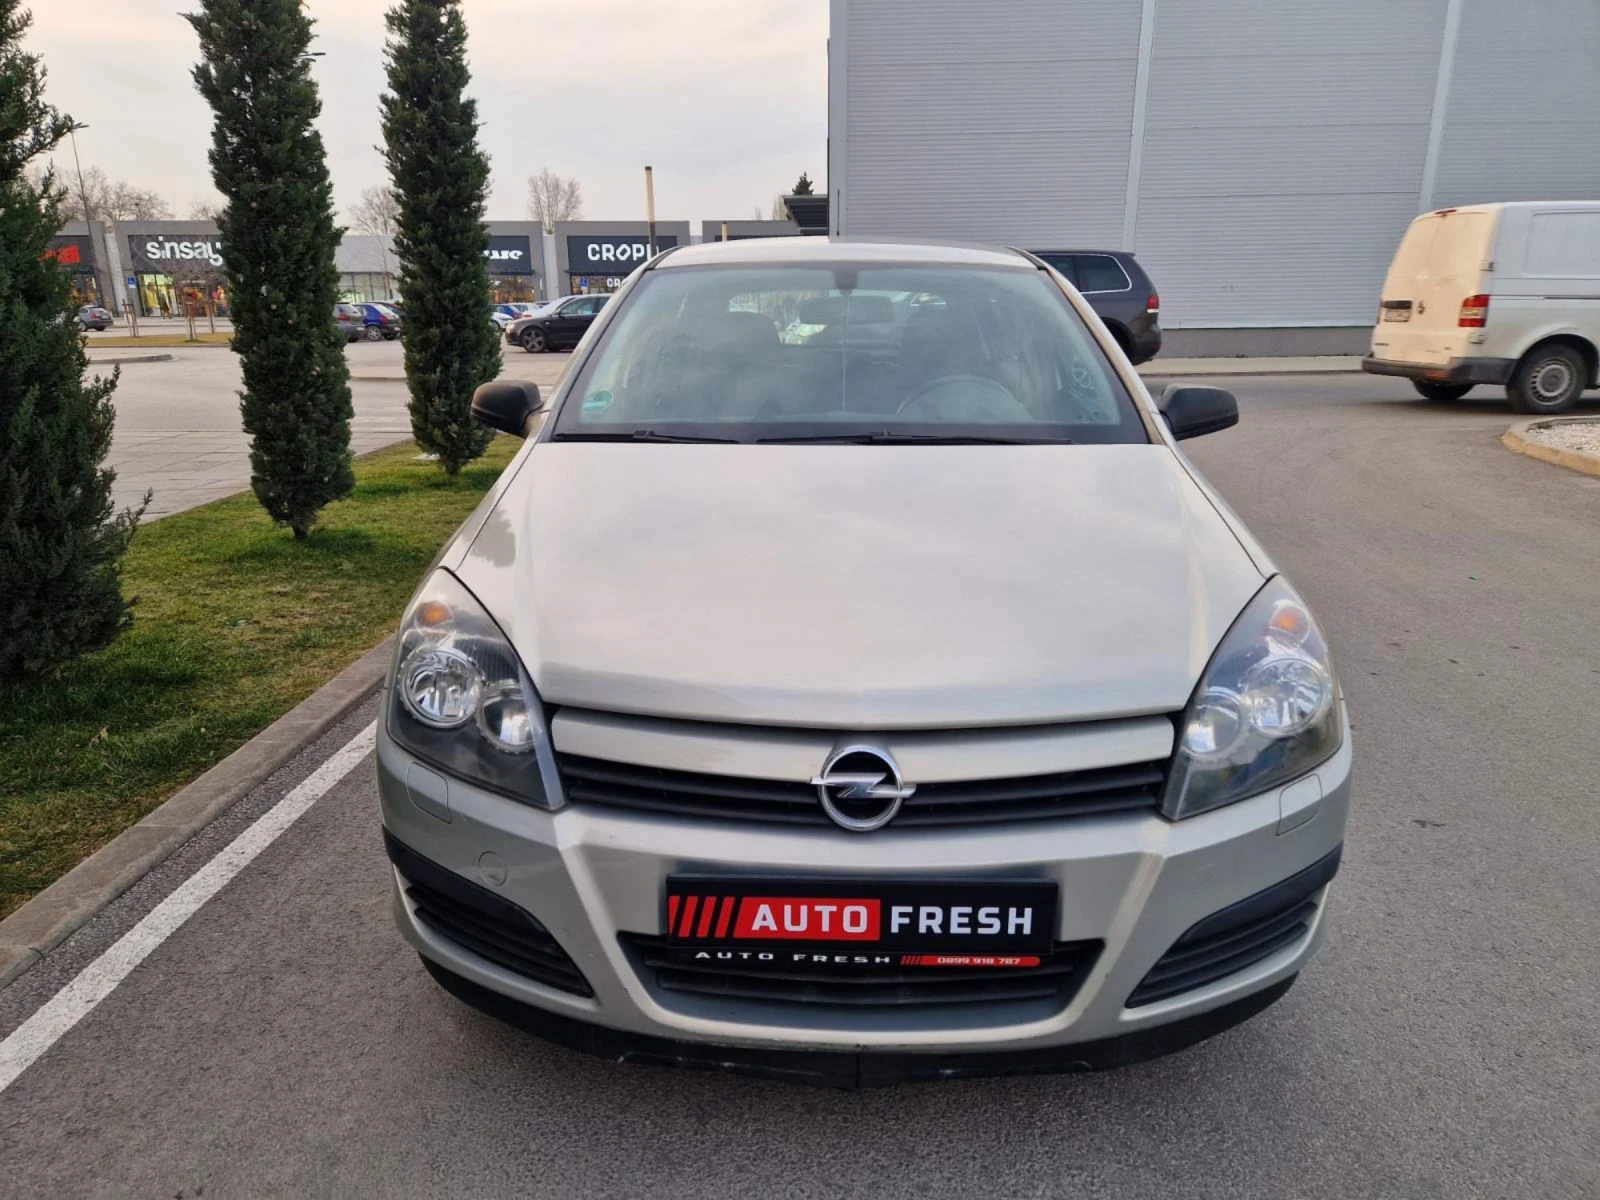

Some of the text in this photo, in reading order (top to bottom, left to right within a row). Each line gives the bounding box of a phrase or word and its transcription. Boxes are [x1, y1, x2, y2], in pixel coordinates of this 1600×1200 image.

[751, 903, 1033, 935] AUTO FRESH
[695, 951, 774, 961] AUTO
[793, 953, 891, 964] FRESH
